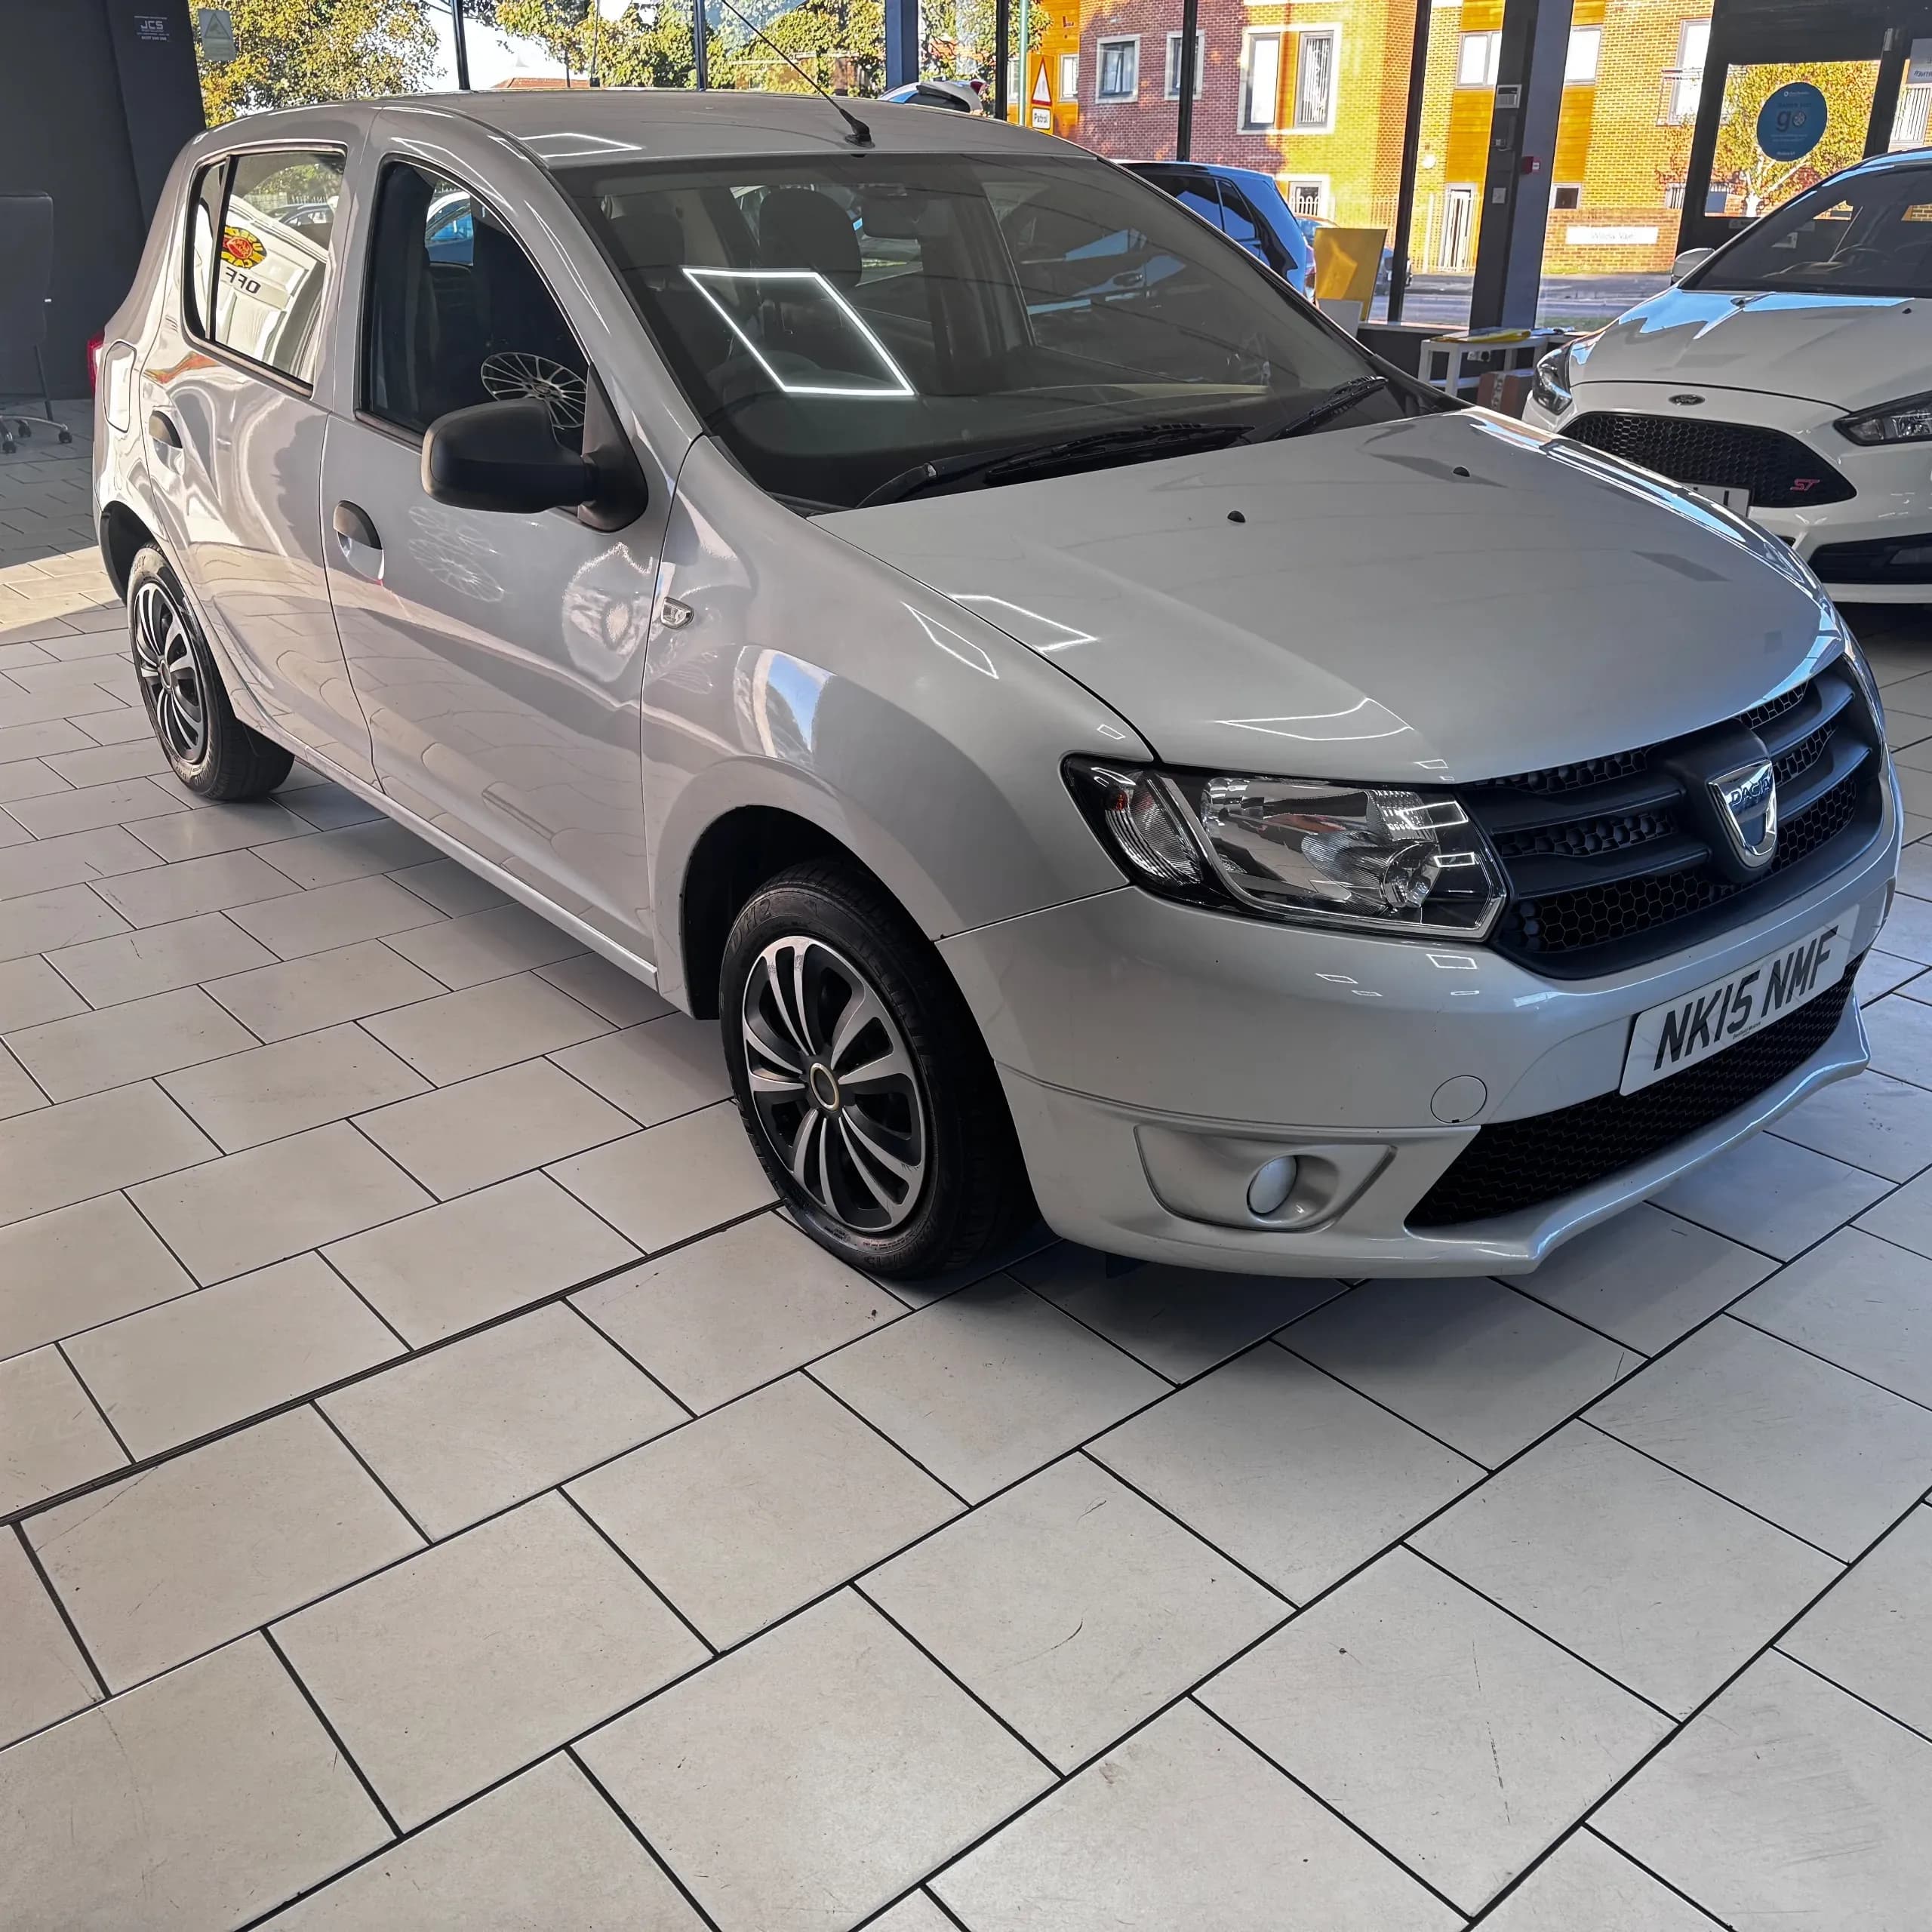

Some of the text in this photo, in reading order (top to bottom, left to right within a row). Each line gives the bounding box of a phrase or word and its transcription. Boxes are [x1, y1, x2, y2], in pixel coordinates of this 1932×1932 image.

[140, 20, 164, 30] JCS
[1789, 478, 1820, 491] ST
[1654, 925, 1839, 1071] NK15 NMF
